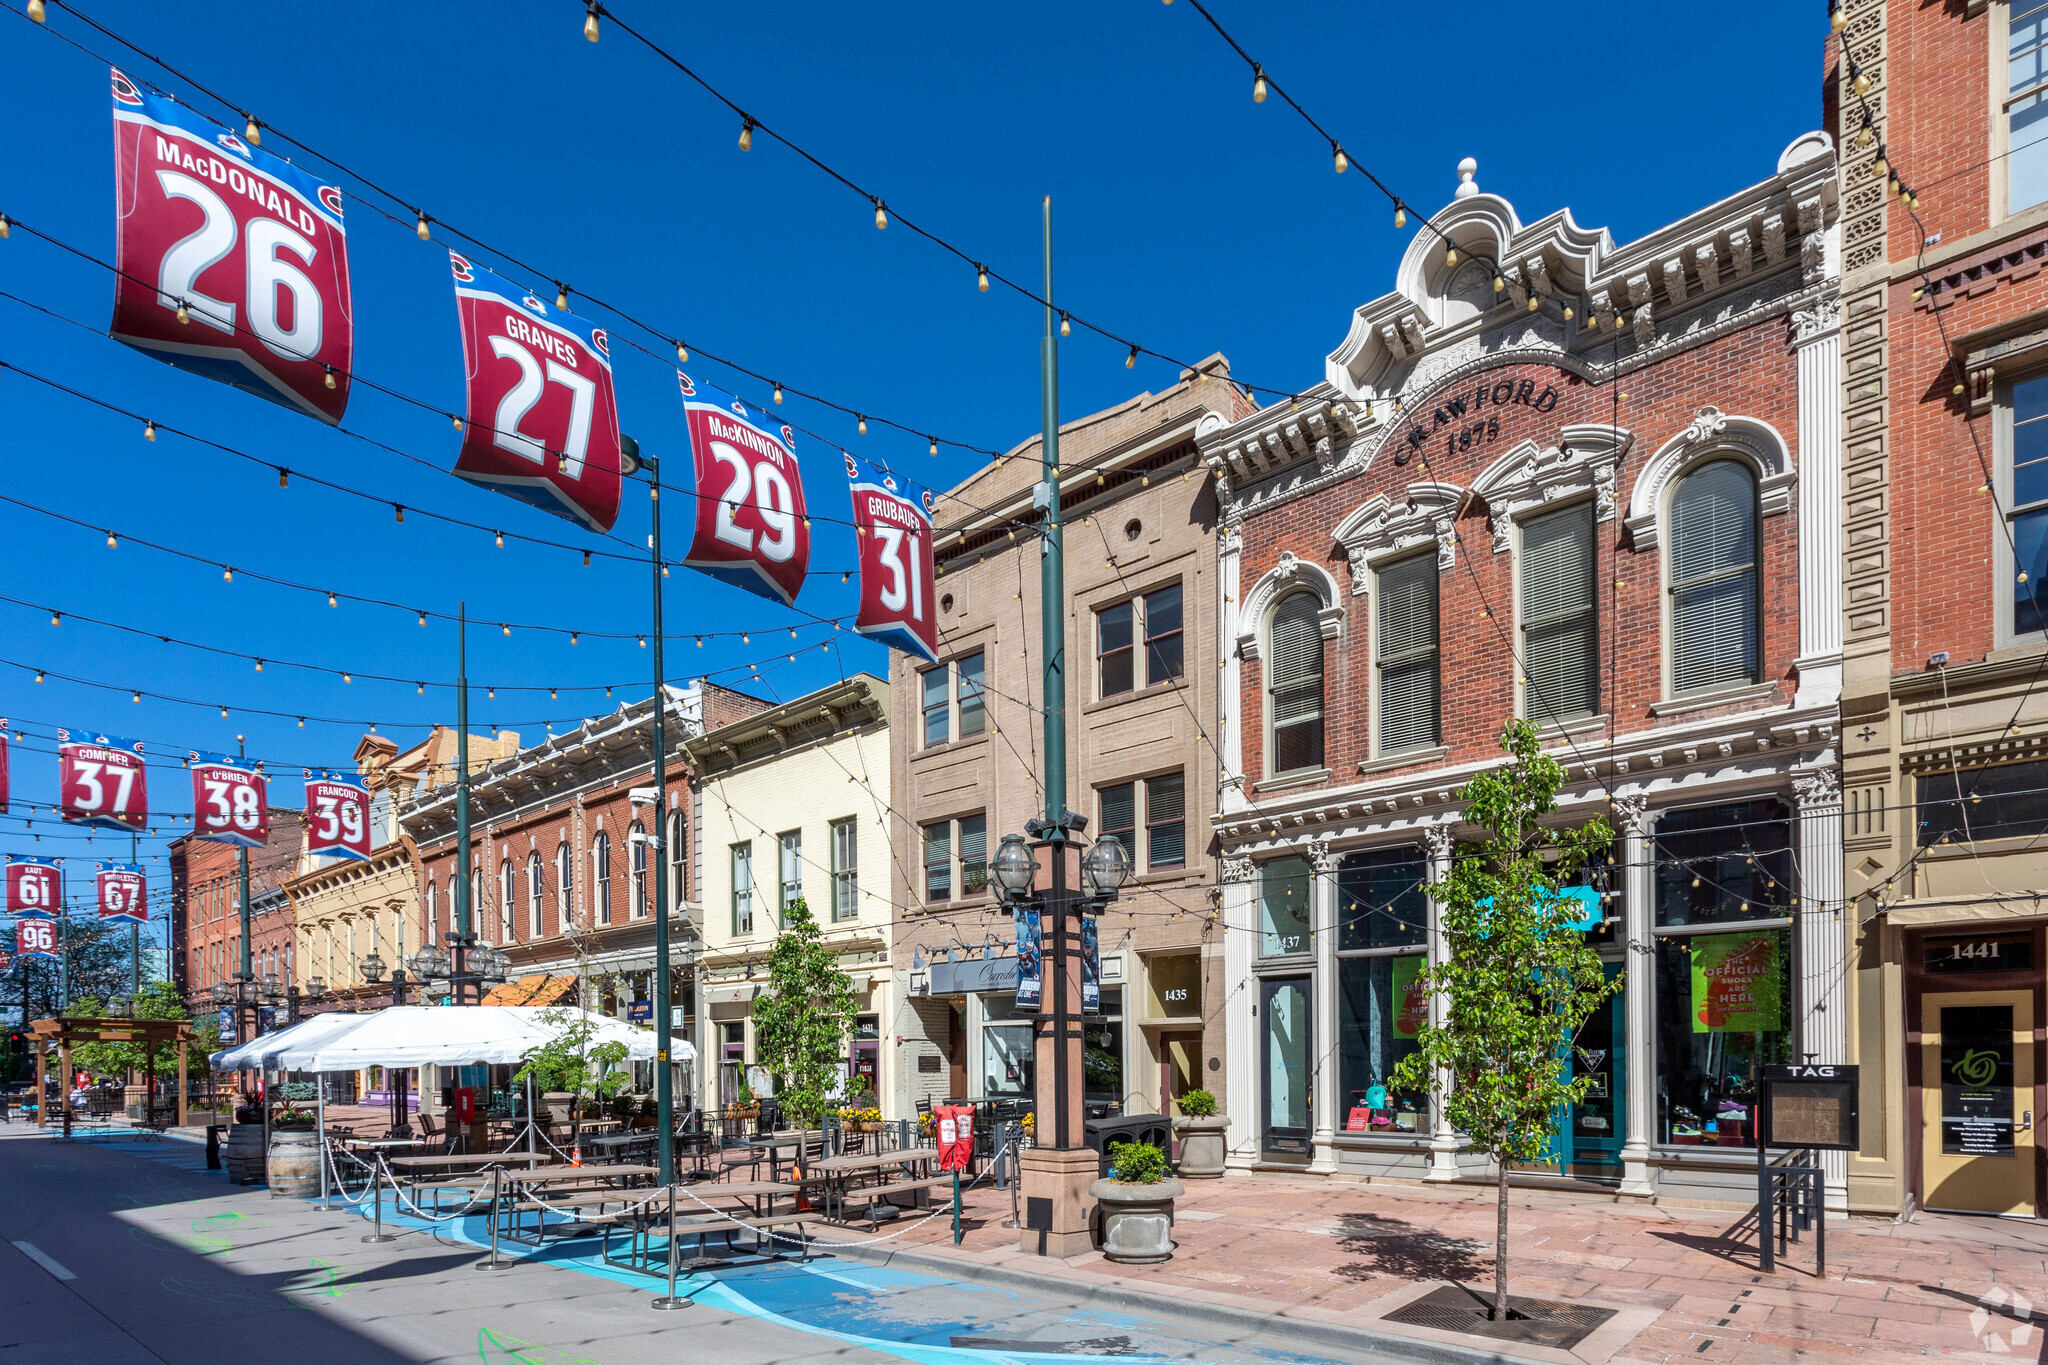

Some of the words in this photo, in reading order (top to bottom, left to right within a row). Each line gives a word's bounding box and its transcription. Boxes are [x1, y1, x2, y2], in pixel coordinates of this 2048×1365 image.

[155, 170, 323, 362] 26
[505, 315, 578, 369] GRAVES
[487, 335, 596, 482] 27
[1395, 379, 1559, 466] CRAWFORD
[1449, 416, 1501, 456] 1875
[709, 441, 796, 563] 29
[868, 497, 922, 537] GRUBAUER
[874, 519, 923, 622] 31
[73, 760, 135, 813] 37
[212, 771, 249, 785] O'BRIEN
[318, 786, 359, 801] FRANCOUZ
[204, 780, 259, 831] 38
[316, 796, 364, 844] 39
[25, 867, 42, 875] KAUT
[20, 875, 50, 906] 61
[104, 882, 140, 912] 67
[23, 927, 52, 949] 96
[1275, 935, 1300, 949] 1437
[1951, 942, 2000, 960] 1441
[979, 961, 1017, 982] Corridor
[1705, 965, 1769, 977] OFFICIAL
[1083, 985, 1099, 996] SCEND
[1164, 988, 1187, 1001] 1435
[1401, 983, 1428, 992] OFFIC
[1720, 993, 1755, 1003] HERE
[862, 1023, 873, 1031] 1431
[1786, 1066, 1835, 1077] TAG
